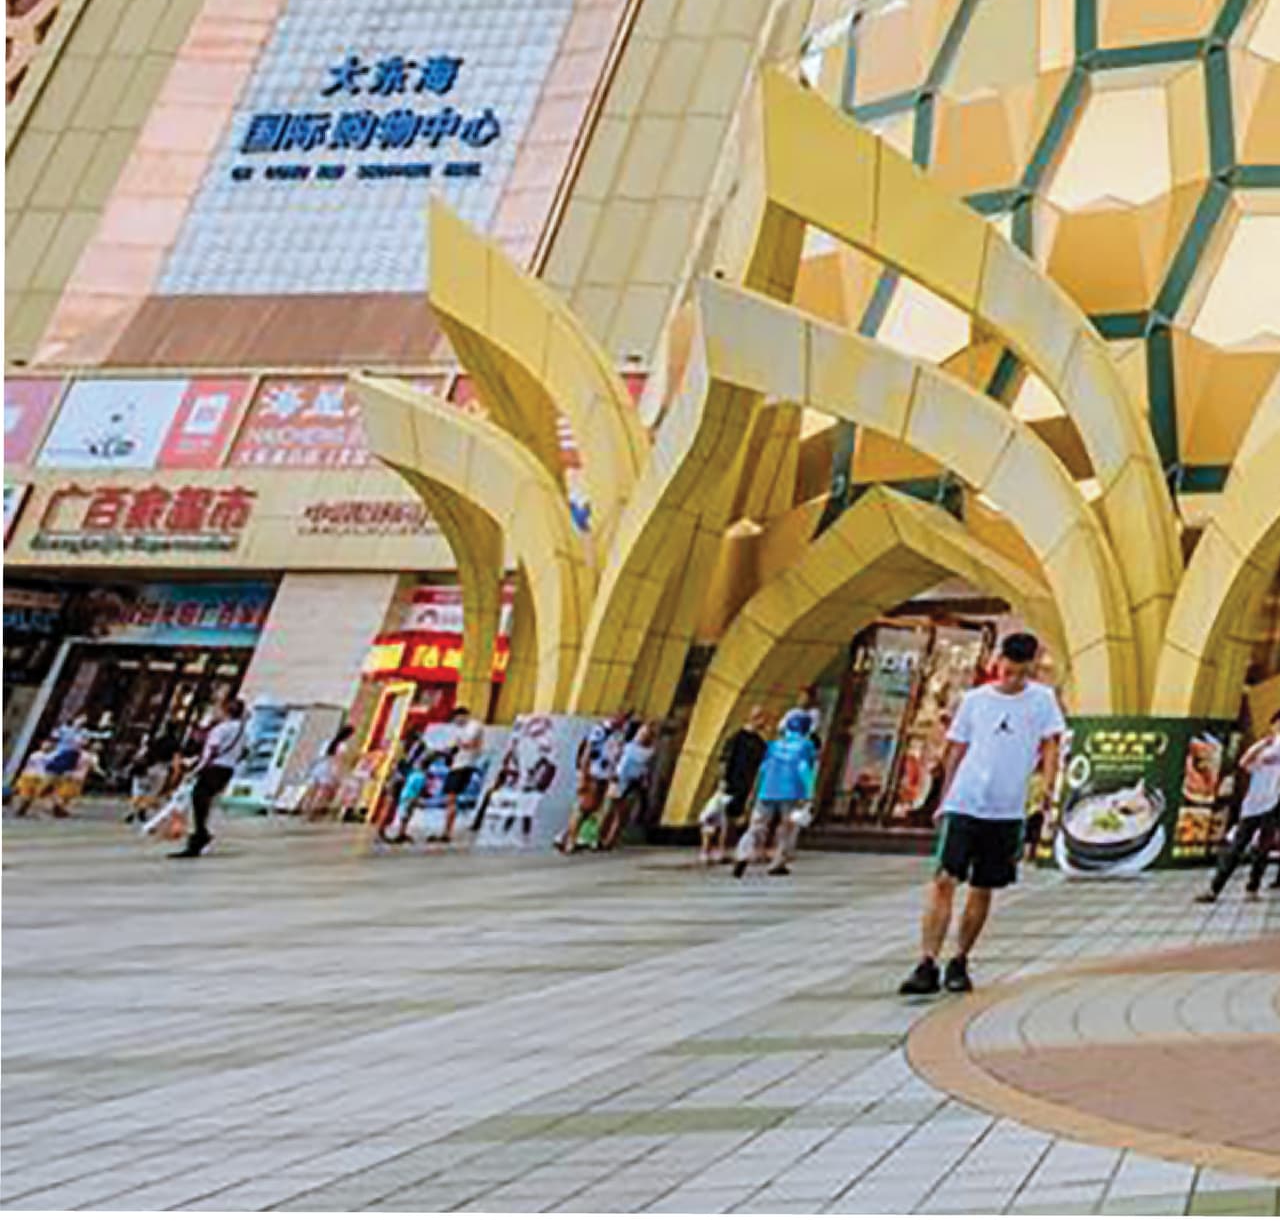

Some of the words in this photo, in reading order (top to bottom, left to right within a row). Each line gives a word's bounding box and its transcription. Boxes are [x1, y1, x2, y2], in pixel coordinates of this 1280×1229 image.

[320, 55, 463, 96] 大东海
[240, 106, 501, 154] 国际购物中心
